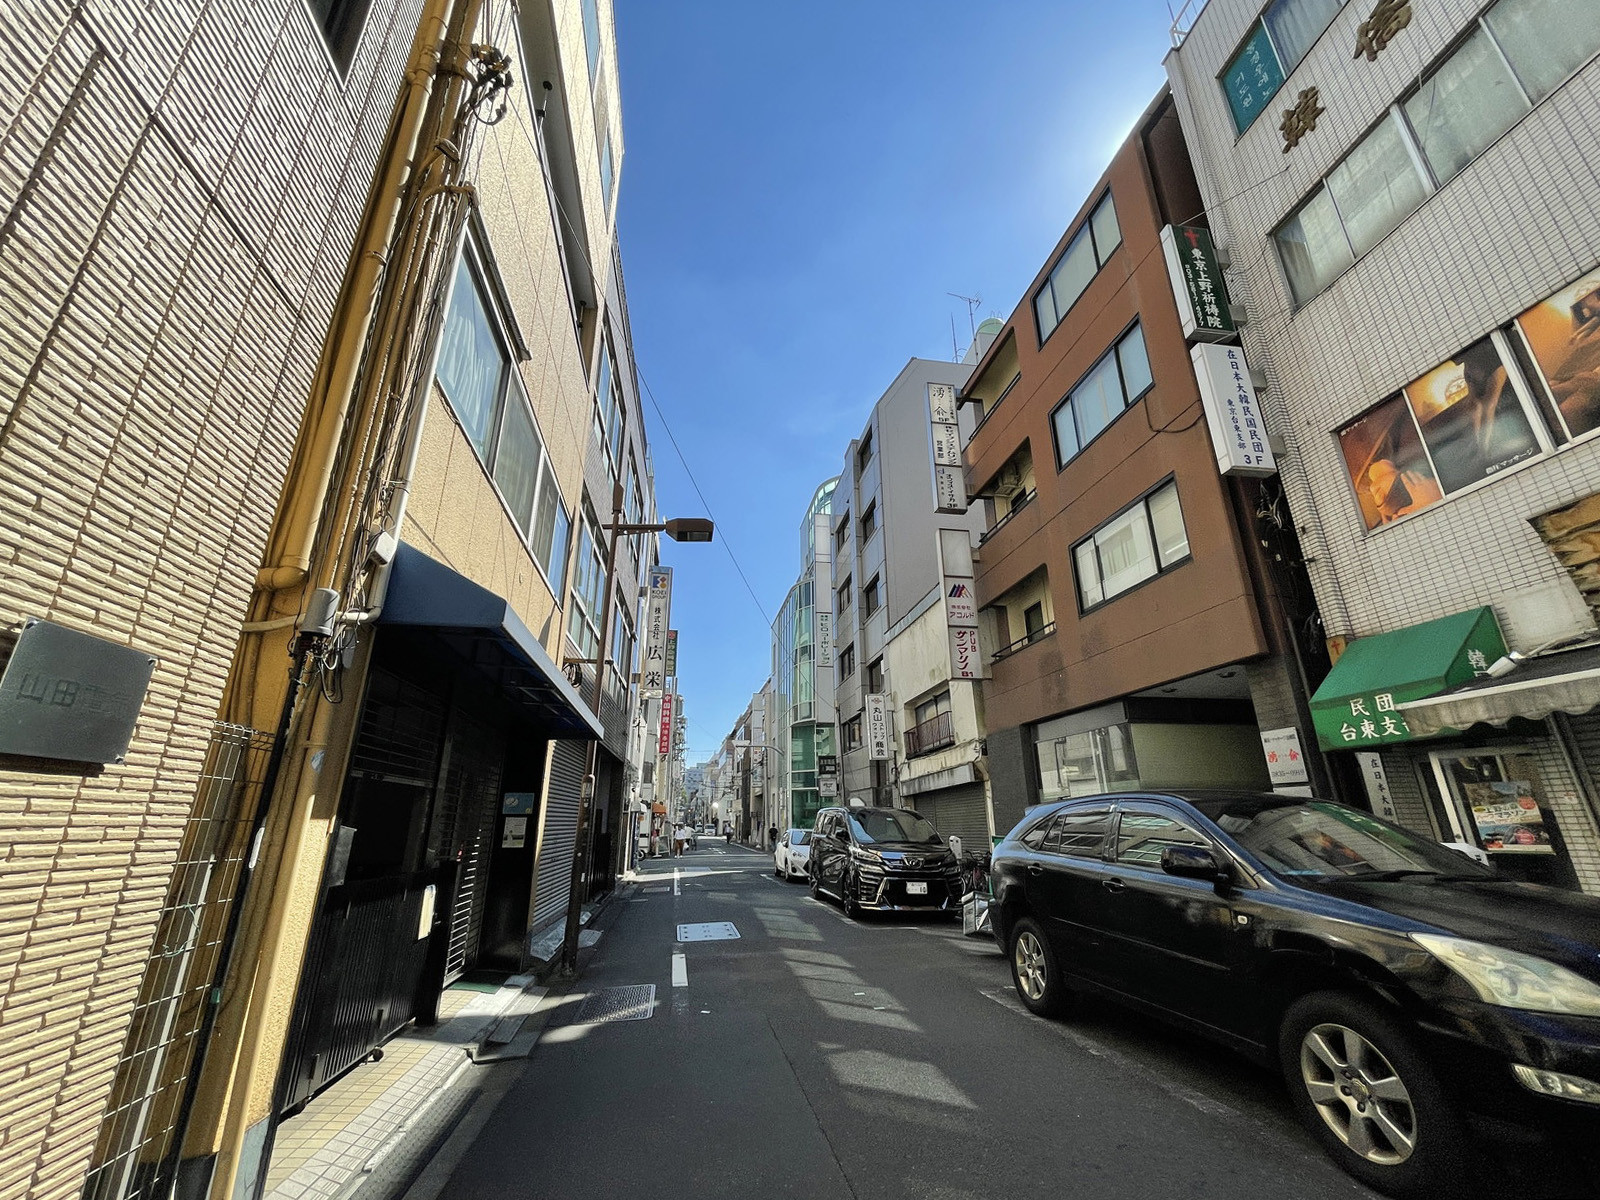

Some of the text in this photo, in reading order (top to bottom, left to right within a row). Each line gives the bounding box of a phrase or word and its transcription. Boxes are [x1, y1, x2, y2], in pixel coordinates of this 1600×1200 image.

[1227, 349, 1264, 453] 在日本大韓民国民団
[1226, 398, 1247, 450] 東京台東支部
[949, 611, 975, 620] アコルド
[645, 607, 663, 688] 株式会社 広栄
[955, 630, 969, 671] サンマリノ
[873, 707, 882, 721] 丸山
[1349, 692, 1395, 716] 民団
[1340, 716, 1410, 742] 台東支
[875, 741, 885, 756] 商会
[1370, 758, 1394, 821] 在日本大韓
